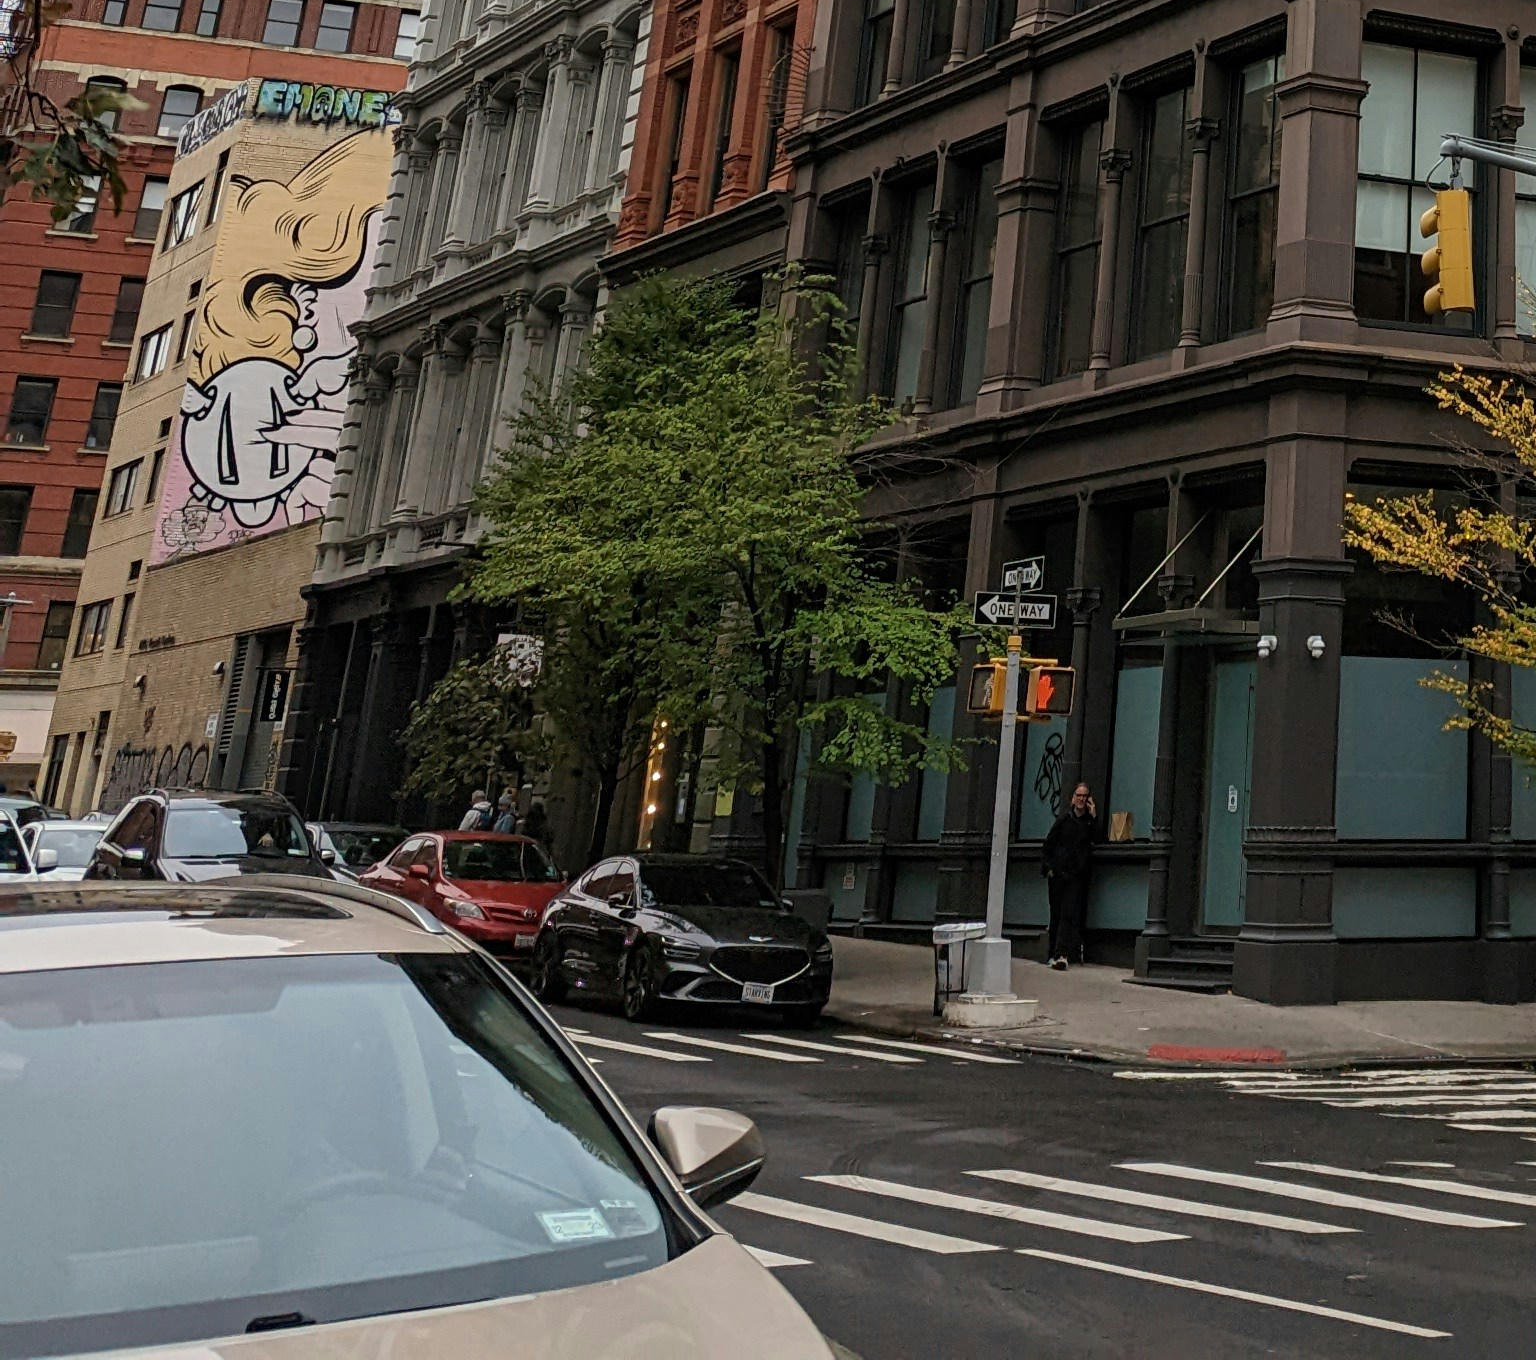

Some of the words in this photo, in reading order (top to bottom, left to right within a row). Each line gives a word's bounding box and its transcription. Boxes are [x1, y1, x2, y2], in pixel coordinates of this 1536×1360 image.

[1026, 569, 1038, 581] WAY
[990, 602, 1014, 616] ONE
[1020, 604, 1045, 617] WAY
